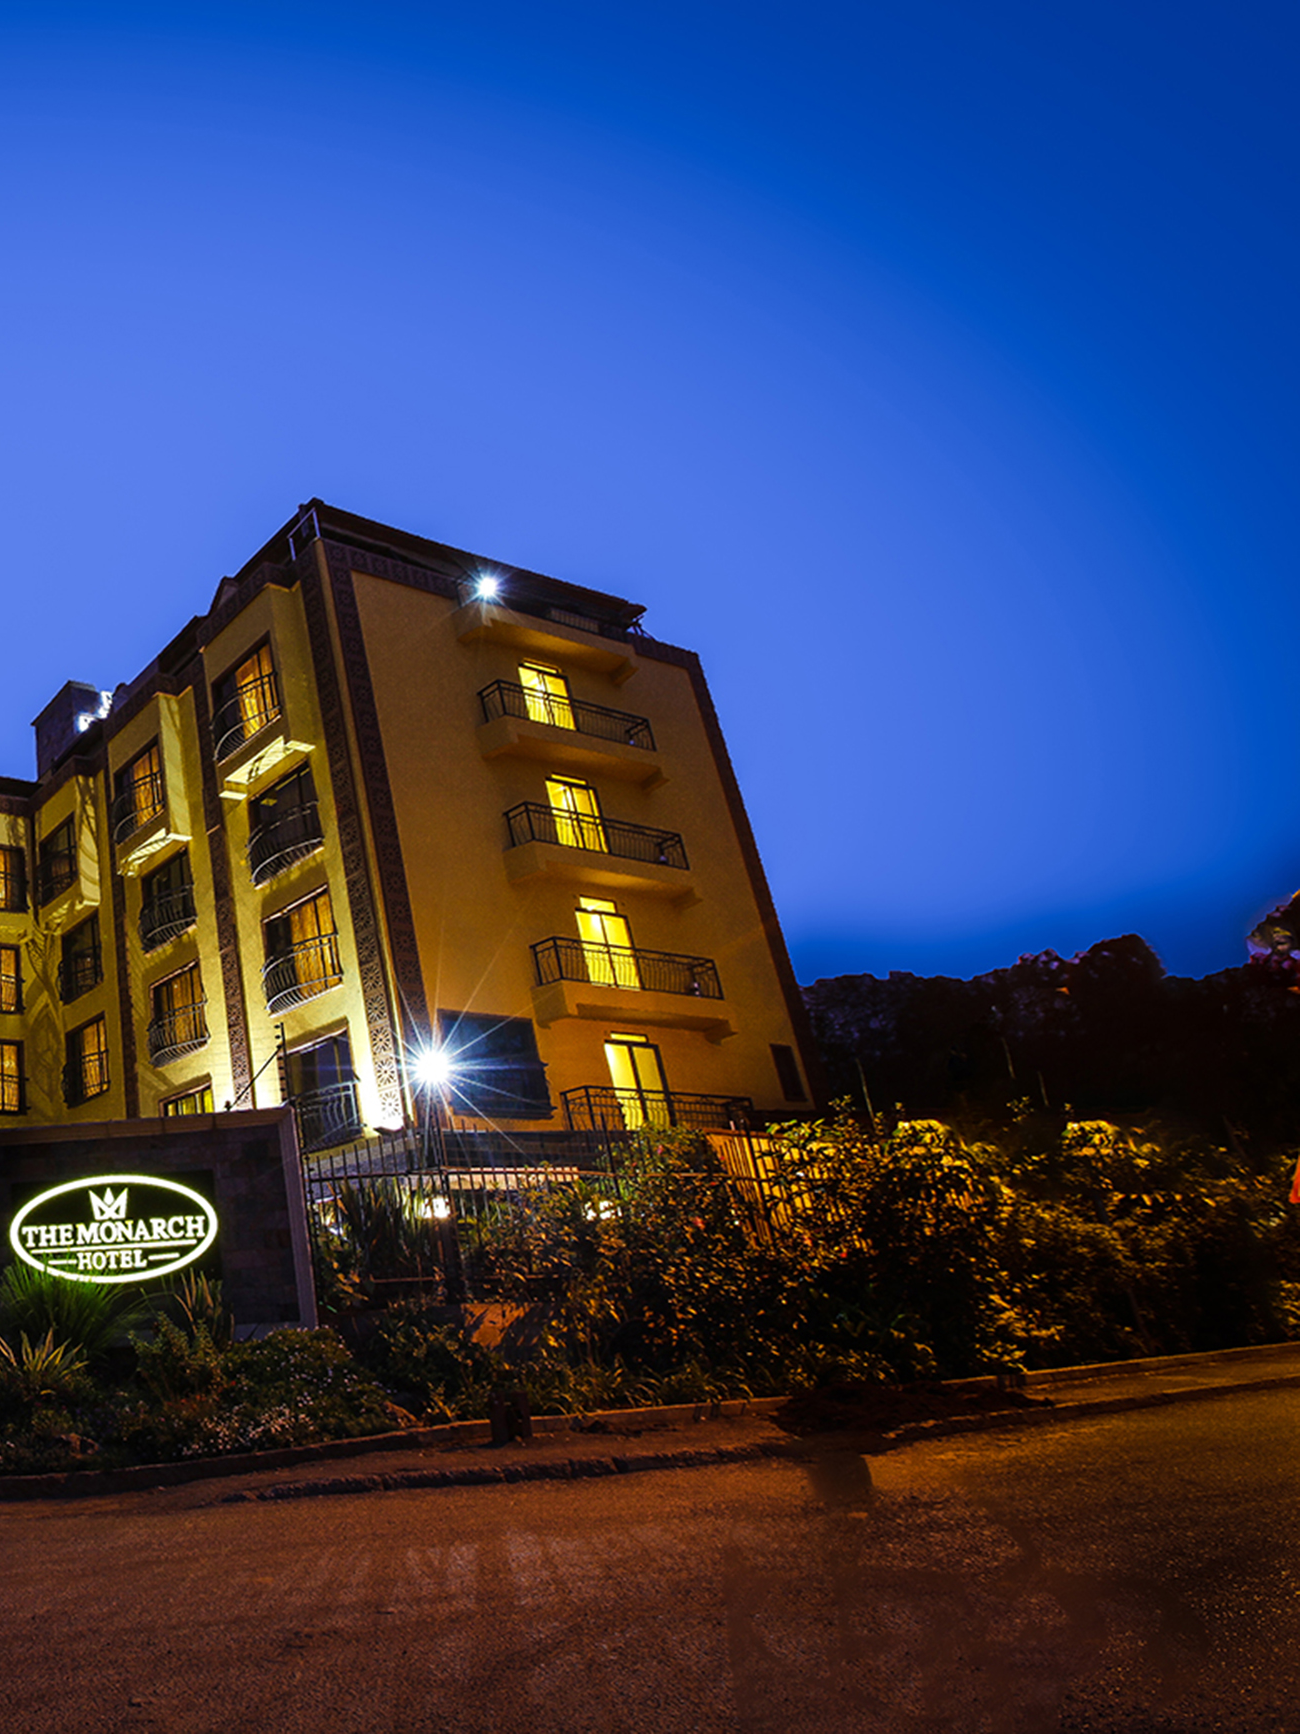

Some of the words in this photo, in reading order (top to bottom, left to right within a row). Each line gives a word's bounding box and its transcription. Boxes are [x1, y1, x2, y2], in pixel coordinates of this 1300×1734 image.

[21, 1224, 74, 1248] THE
[76, 1215, 206, 1245] MONARCH
[76, 1249, 148, 1271] HOTEL
